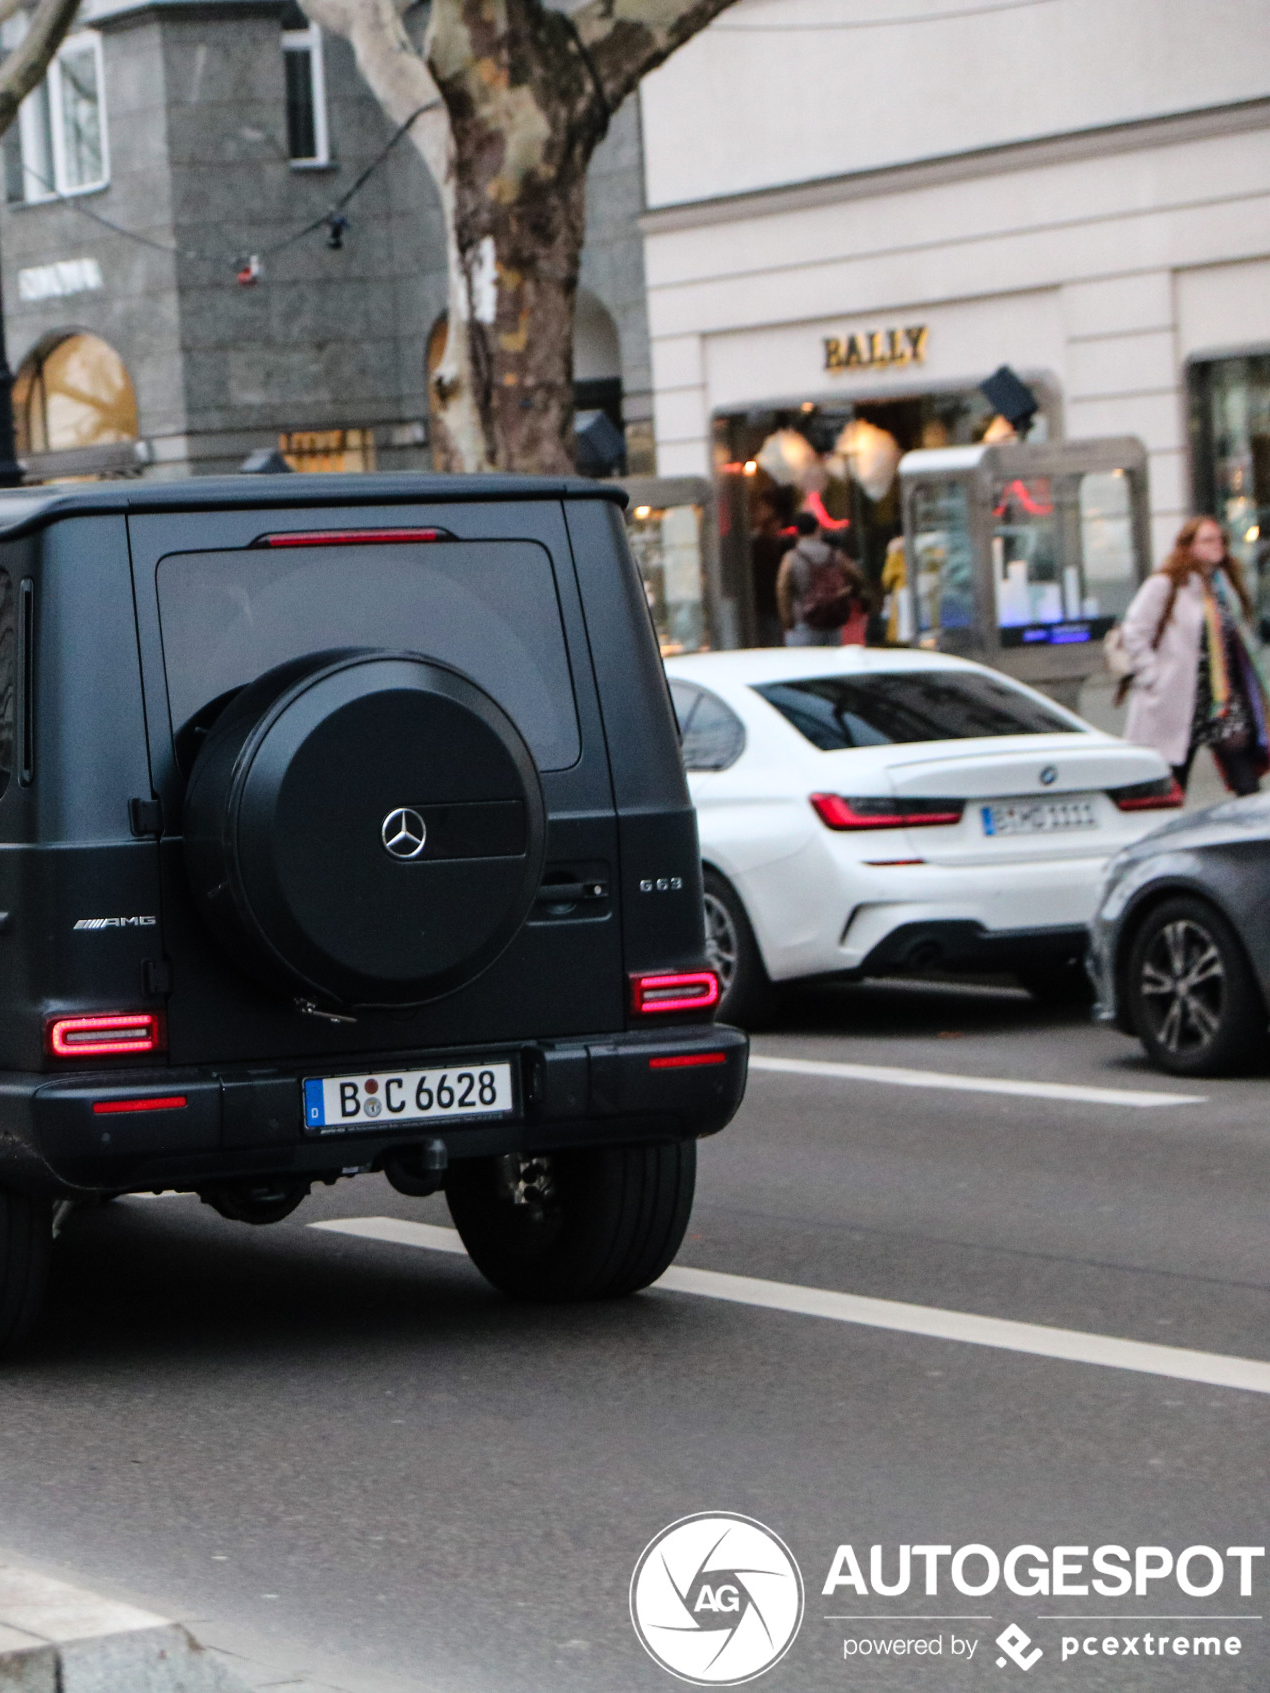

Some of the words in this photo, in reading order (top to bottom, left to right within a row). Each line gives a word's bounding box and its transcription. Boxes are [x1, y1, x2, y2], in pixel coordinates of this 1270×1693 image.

[823, 325, 929, 371] BALLY
[101, 915, 156, 929] AMG
[311, 1107, 319, 1119] D
[339, 1081, 361, 1118] B
[385, 1077, 406, 1113] C
[414, 1070, 497, 1111] 6628
